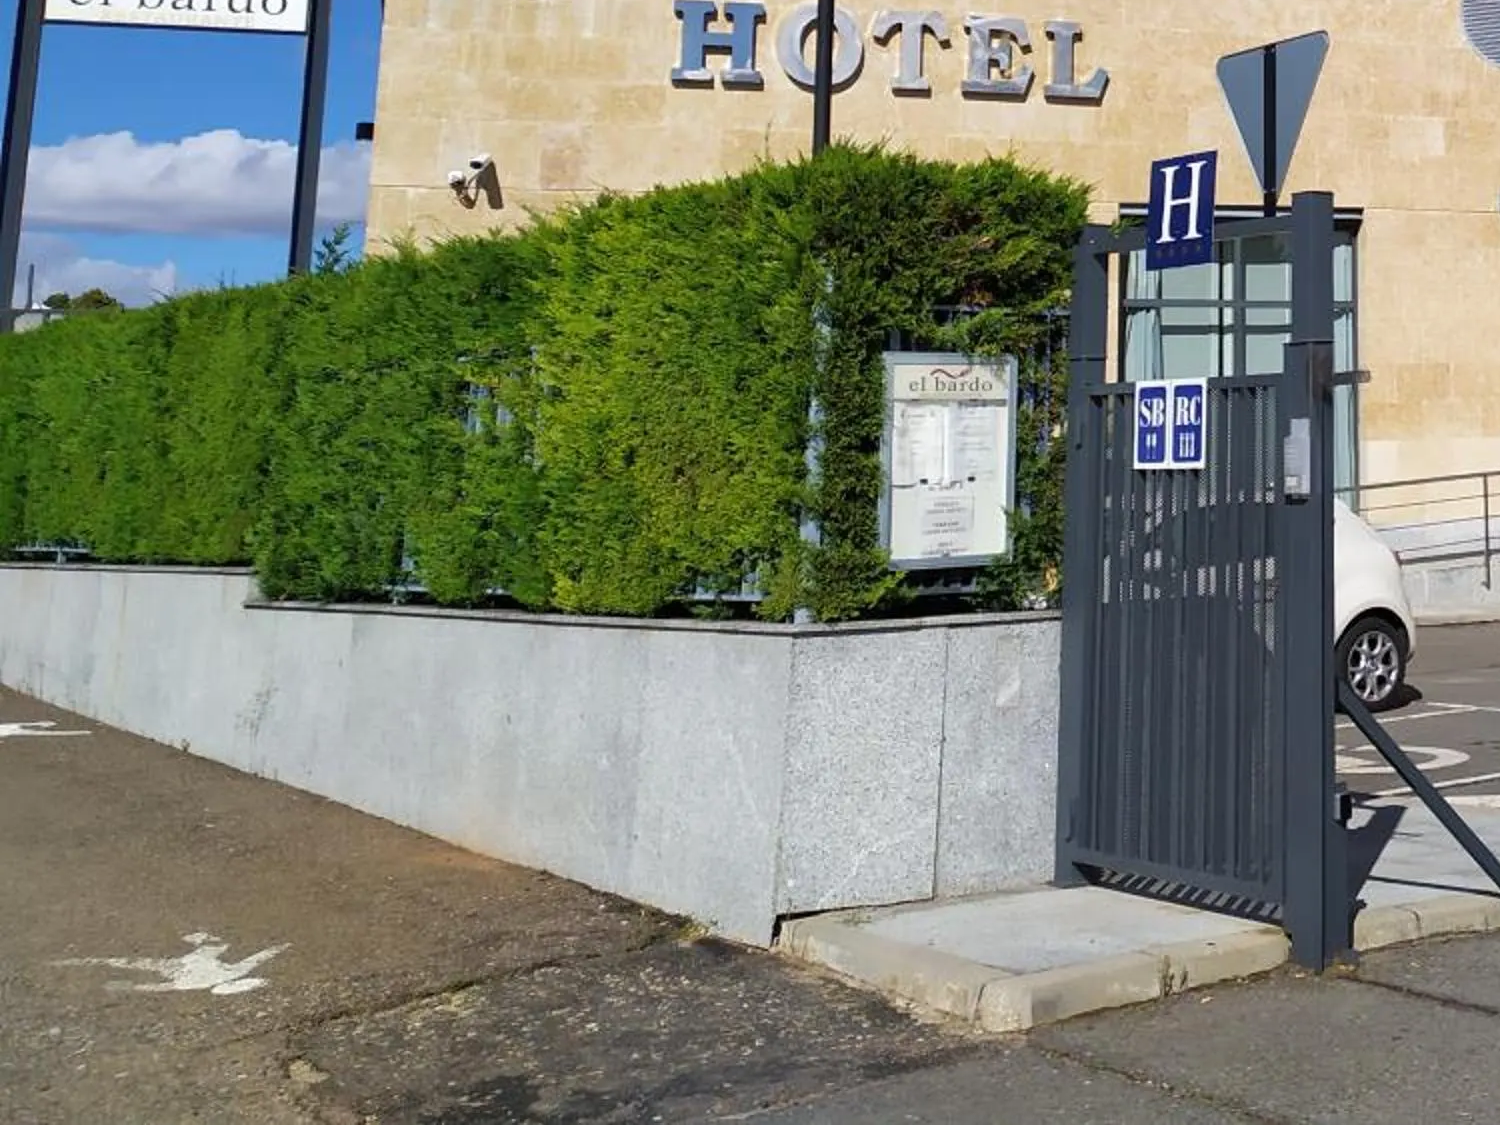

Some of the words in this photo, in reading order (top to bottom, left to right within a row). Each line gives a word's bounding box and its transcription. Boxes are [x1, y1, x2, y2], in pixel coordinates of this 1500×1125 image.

[1155, 160, 1208, 244] H
[934, 376, 993, 392] bardo
[1139, 398, 1165, 428] SB
[1175, 395, 1201, 426] RC
